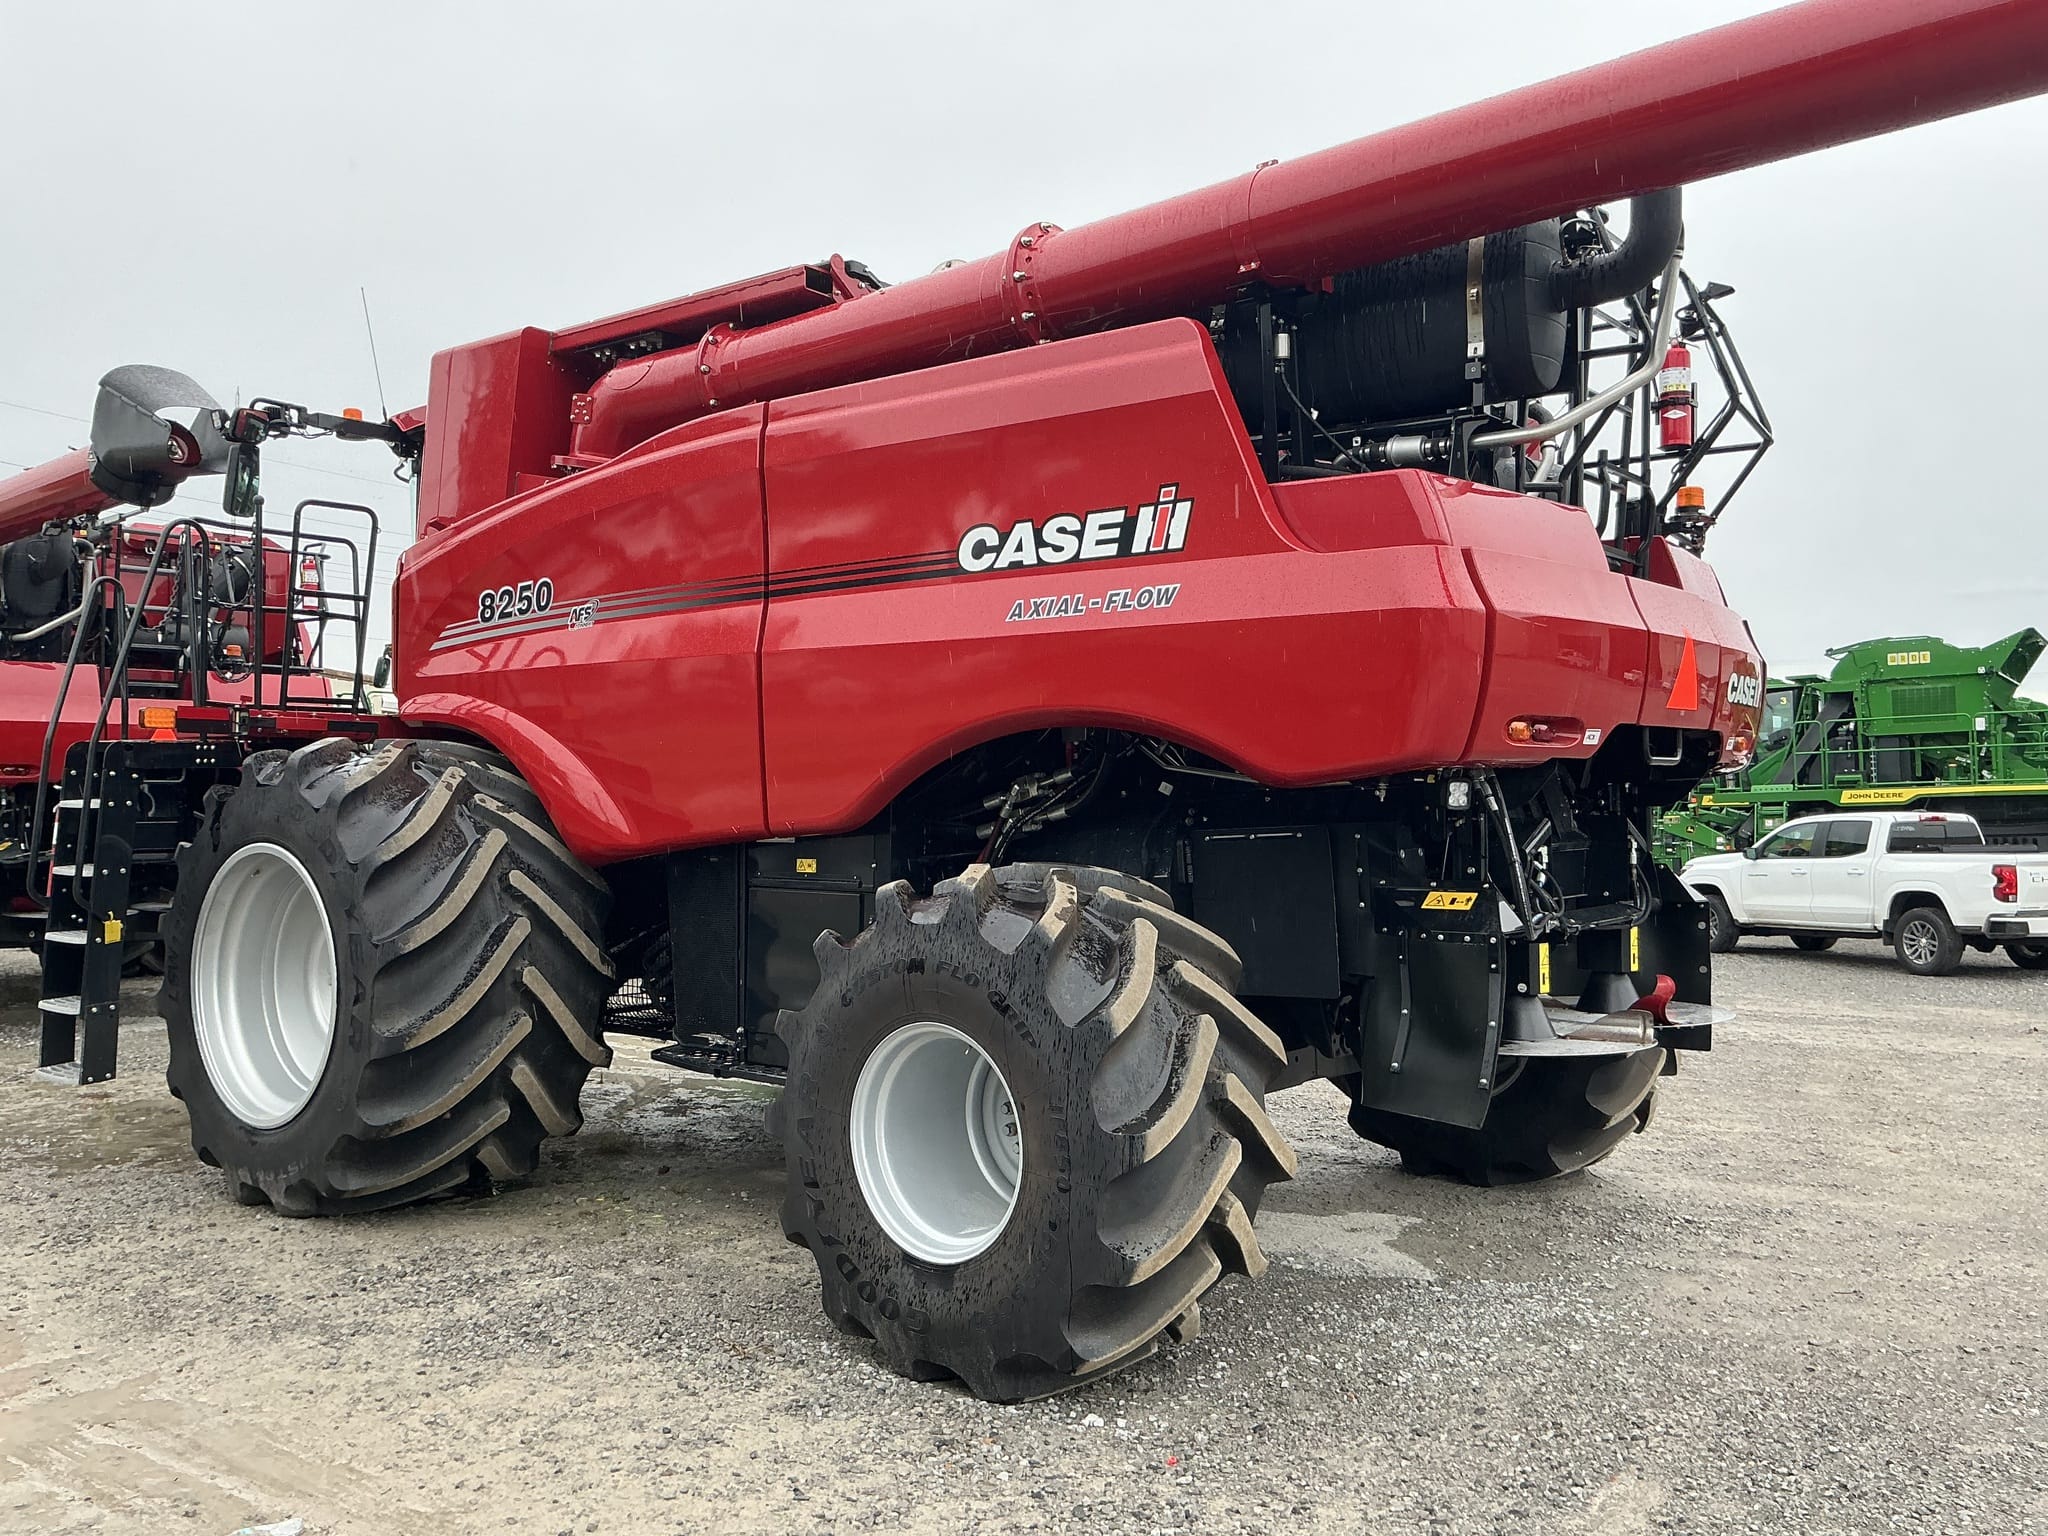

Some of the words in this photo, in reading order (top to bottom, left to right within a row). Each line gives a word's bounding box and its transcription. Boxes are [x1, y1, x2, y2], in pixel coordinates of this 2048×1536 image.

[957, 509, 1126, 572] CASE
[478, 577, 553, 624] 8250
[569, 604, 594, 624] AFS
[1727, 672, 1755, 706] CASE
[936, 959, 980, 987] FLO
